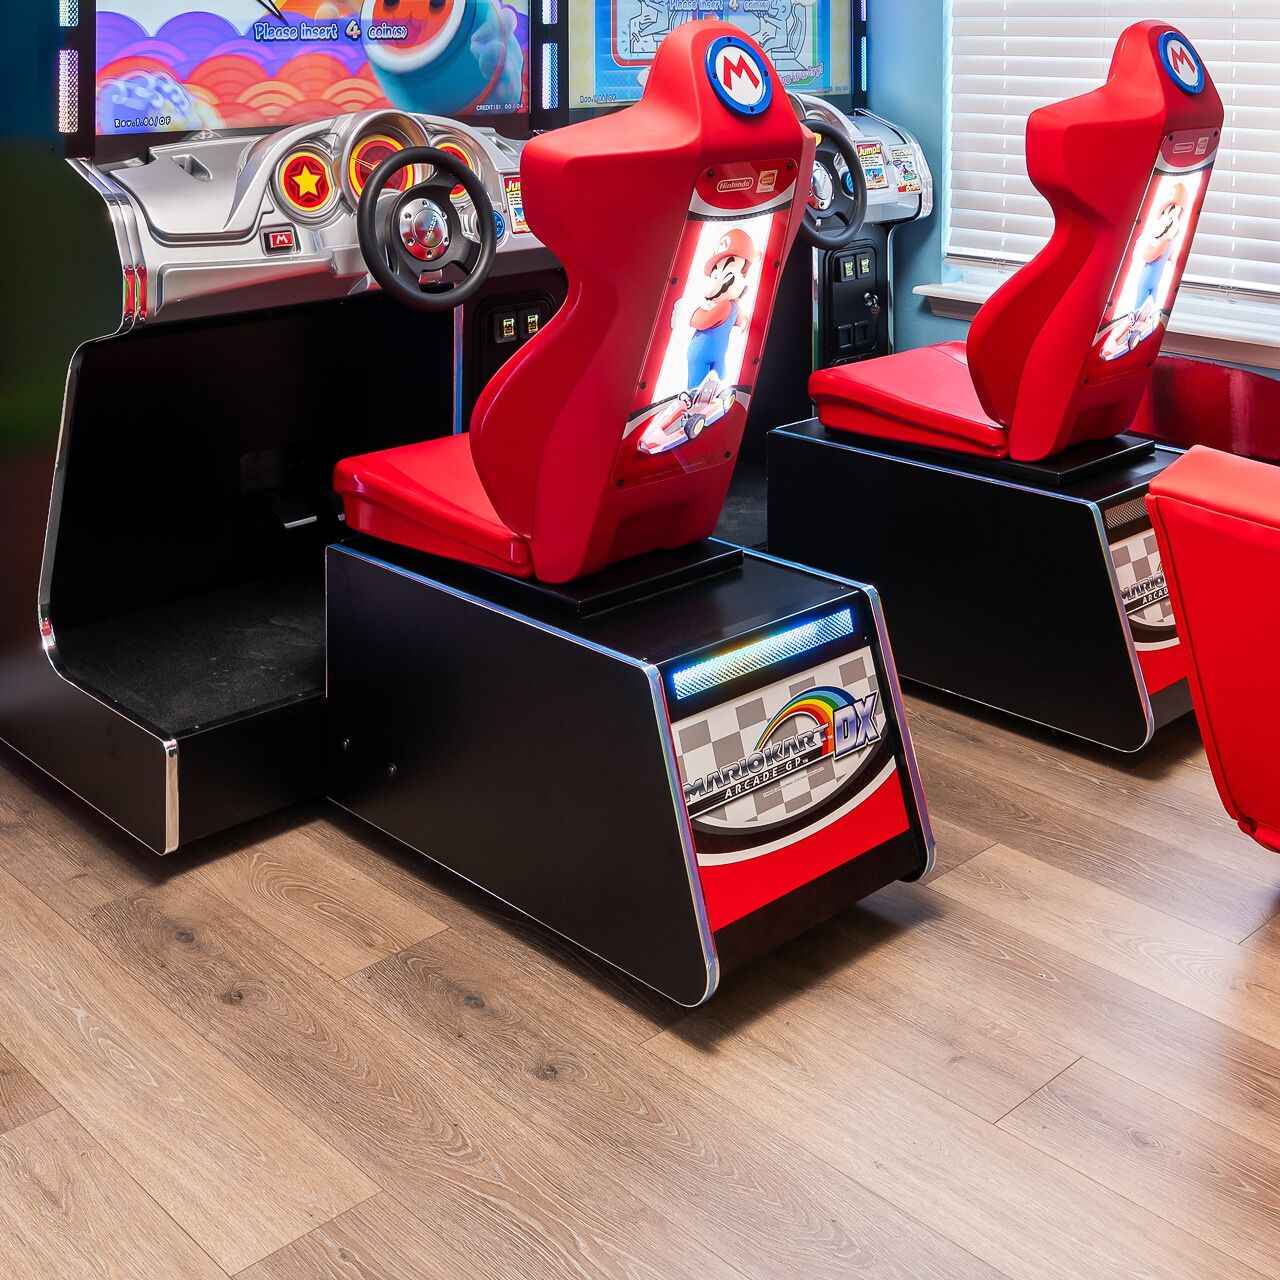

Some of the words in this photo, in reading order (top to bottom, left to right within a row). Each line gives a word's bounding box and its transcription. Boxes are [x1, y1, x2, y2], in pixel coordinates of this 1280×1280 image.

[254, 21, 298, 41] Please
[300, 21, 338, 40] insert
[345, 19, 361, 40] 4
[367, 25, 408, 40] coin(s)
[719, 179, 751, 190] Nintendo
[1142, 587, 1168, 605] ARCAD
[833, 690, 881, 761] DX
[724, 766, 779, 800] ARCADE
